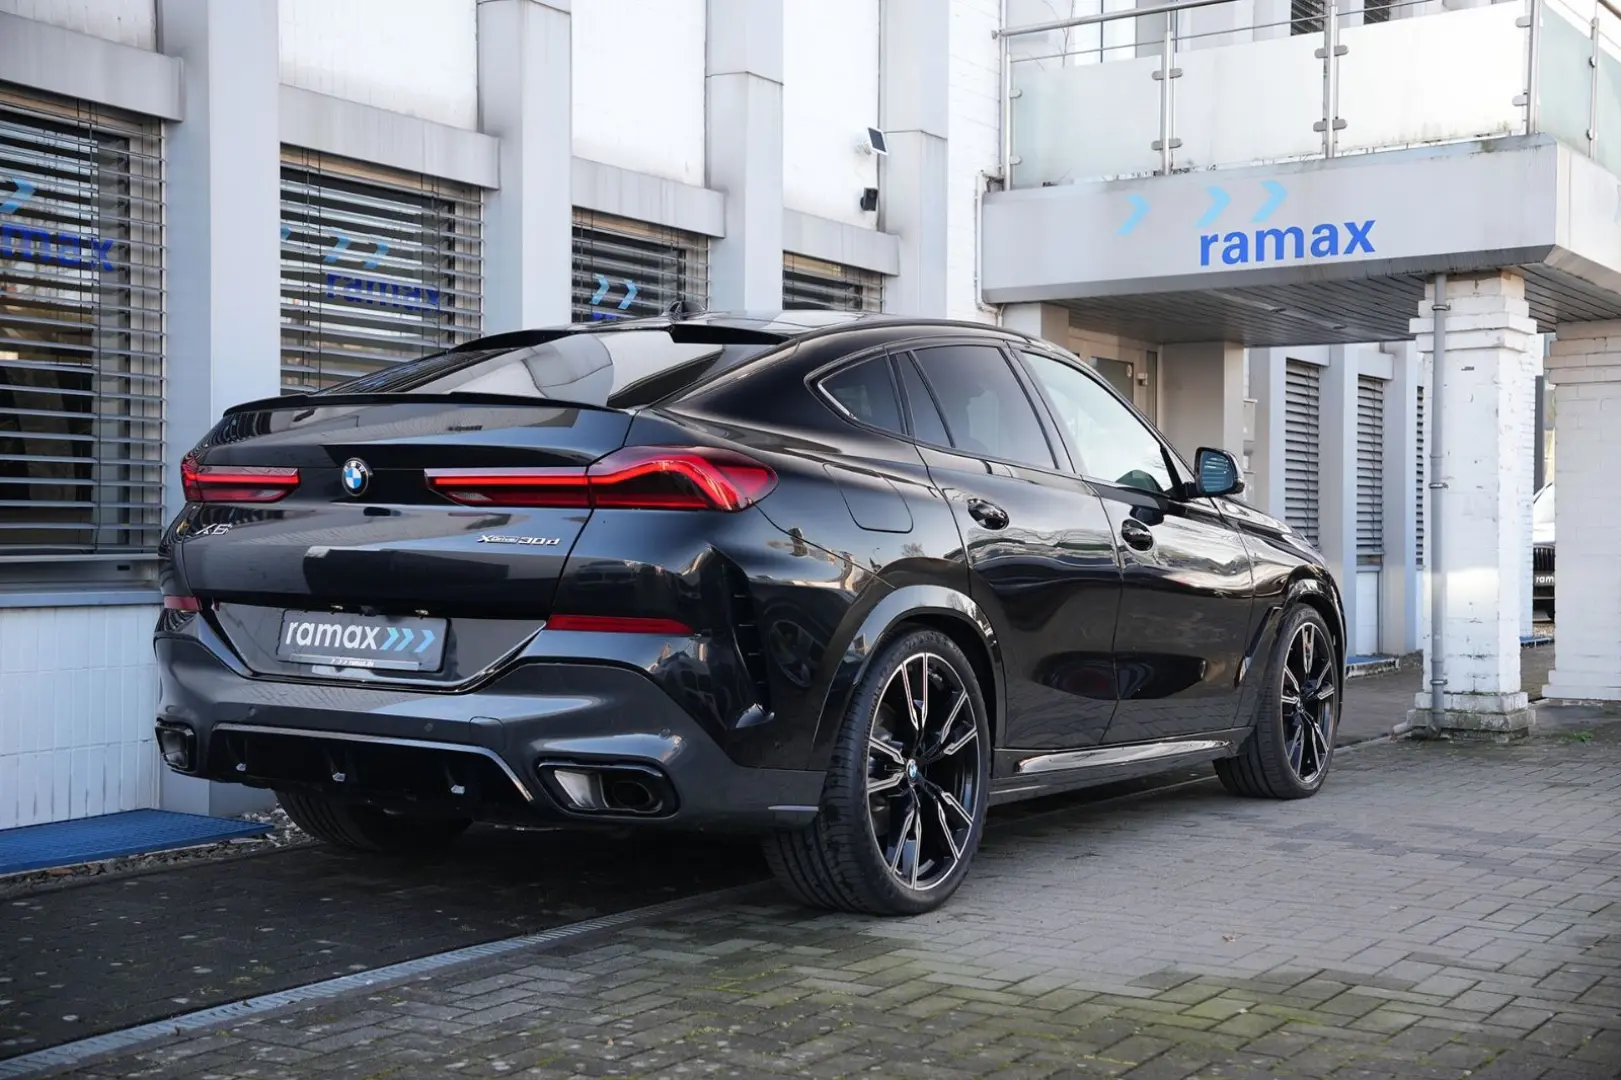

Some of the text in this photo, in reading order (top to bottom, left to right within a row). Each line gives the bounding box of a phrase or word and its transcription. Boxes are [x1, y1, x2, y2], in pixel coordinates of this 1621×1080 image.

[1200, 220, 1376, 266] ramax
[327, 273, 441, 312] ramax
[285, 621, 381, 650] ramax
